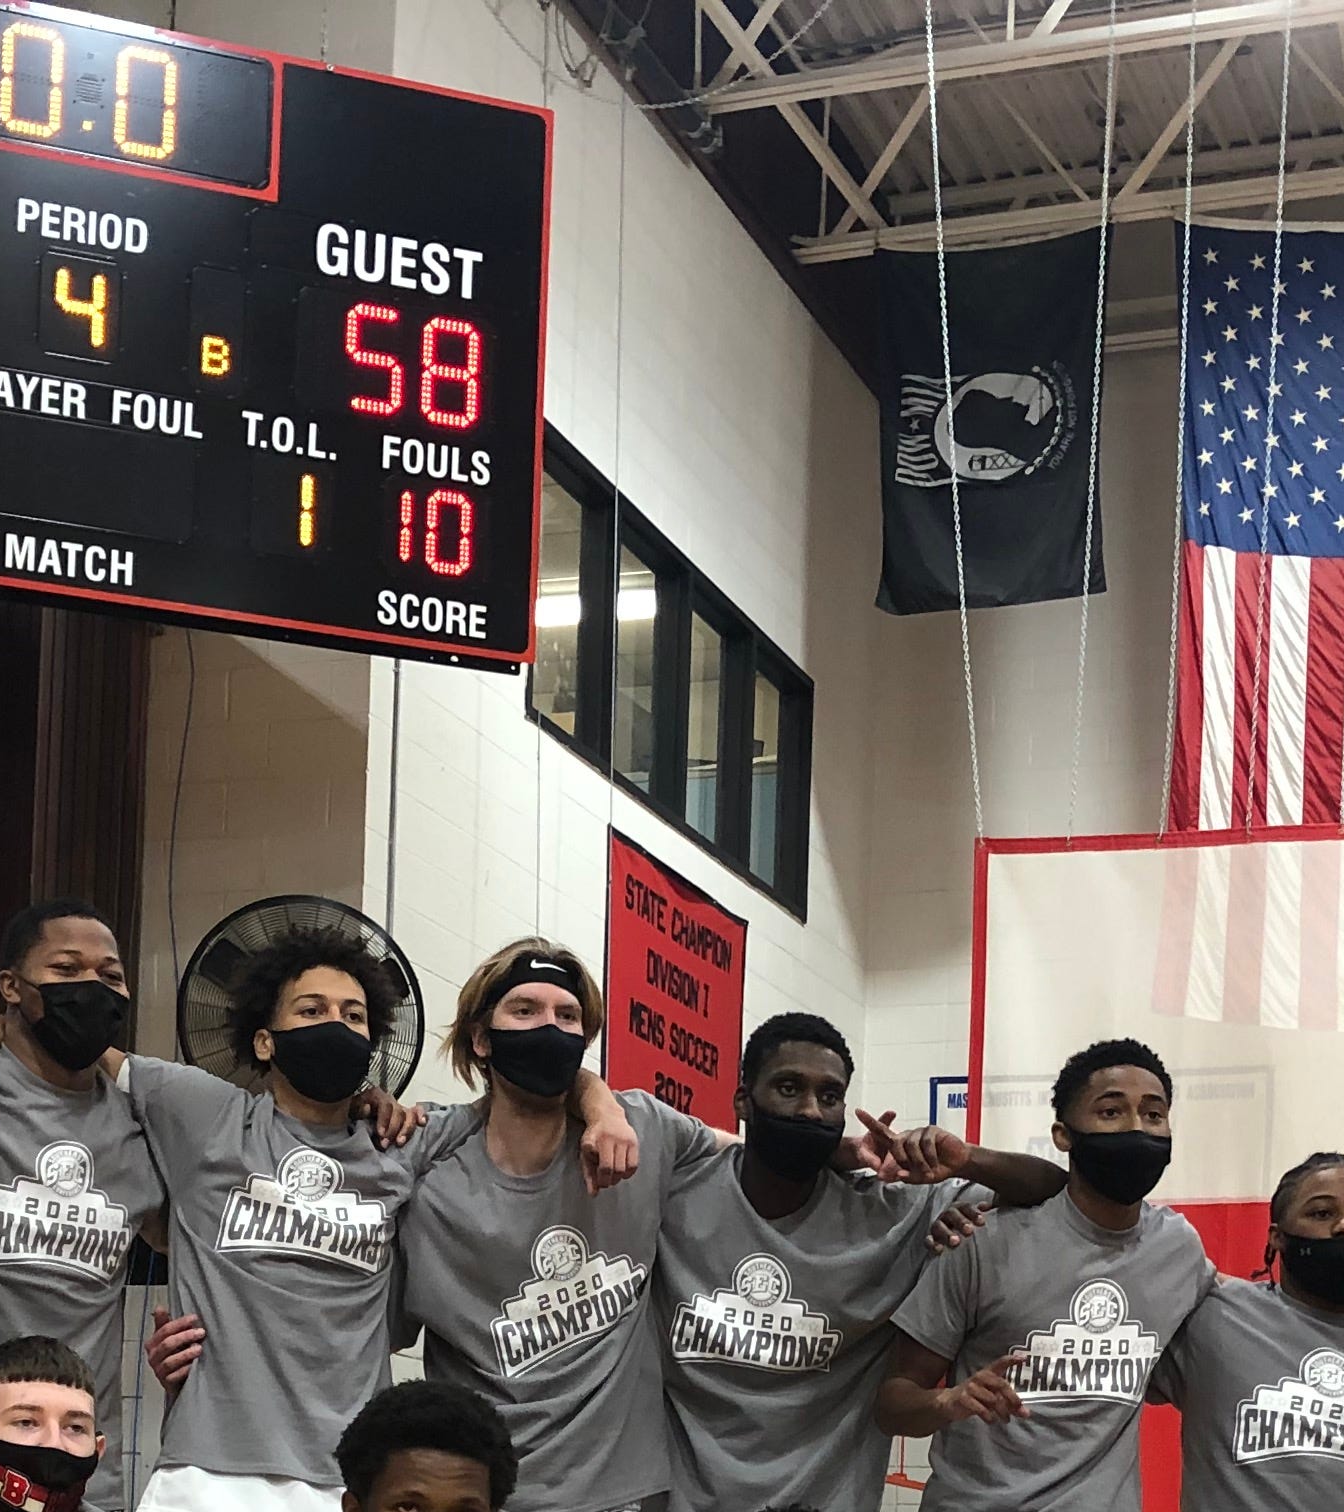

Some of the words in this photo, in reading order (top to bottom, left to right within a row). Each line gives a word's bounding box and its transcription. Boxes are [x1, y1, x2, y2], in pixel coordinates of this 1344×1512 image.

[16, 198, 148, 254] PERIOD
[317, 223, 483, 300] GUEST
[55, 266, 107, 348] 4
[201, 336, 231, 376] B
[346, 302, 481, 429] 58
[111, 389, 203, 439] FOUL
[242, 411, 337, 461] T.O.L.
[382, 435, 491, 486] FOULS
[895, 433, 968, 486] POW
[300, 474, 315, 547] 1
[399, 489, 472, 576] 10
[5, 533, 134, 586] MATCH
[377, 590, 487, 639] SCORE
[624, 874, 667, 934] STATE
[672, 907, 732, 974] CHAMPION
[646, 948, 699, 1013] DIVISION
[628, 997, 665, 1050] MENS
[669, 1022, 719, 1080] SOCCER
[24, 1196, 97, 1224] 2020
[536, 1273, 604, 1311] 2020
[739, 1275, 781, 1297] SEC
[724, 1307, 793, 1332] 2020
[1079, 1299, 1118, 1326] SEC
[675, 1311, 834, 1367] CHAMPIONS
[1062, 1338, 1130, 1355] 2020
[1007, 1354, 1159, 1396] CHAMPION
[1, 1468, 30, 1507] B
